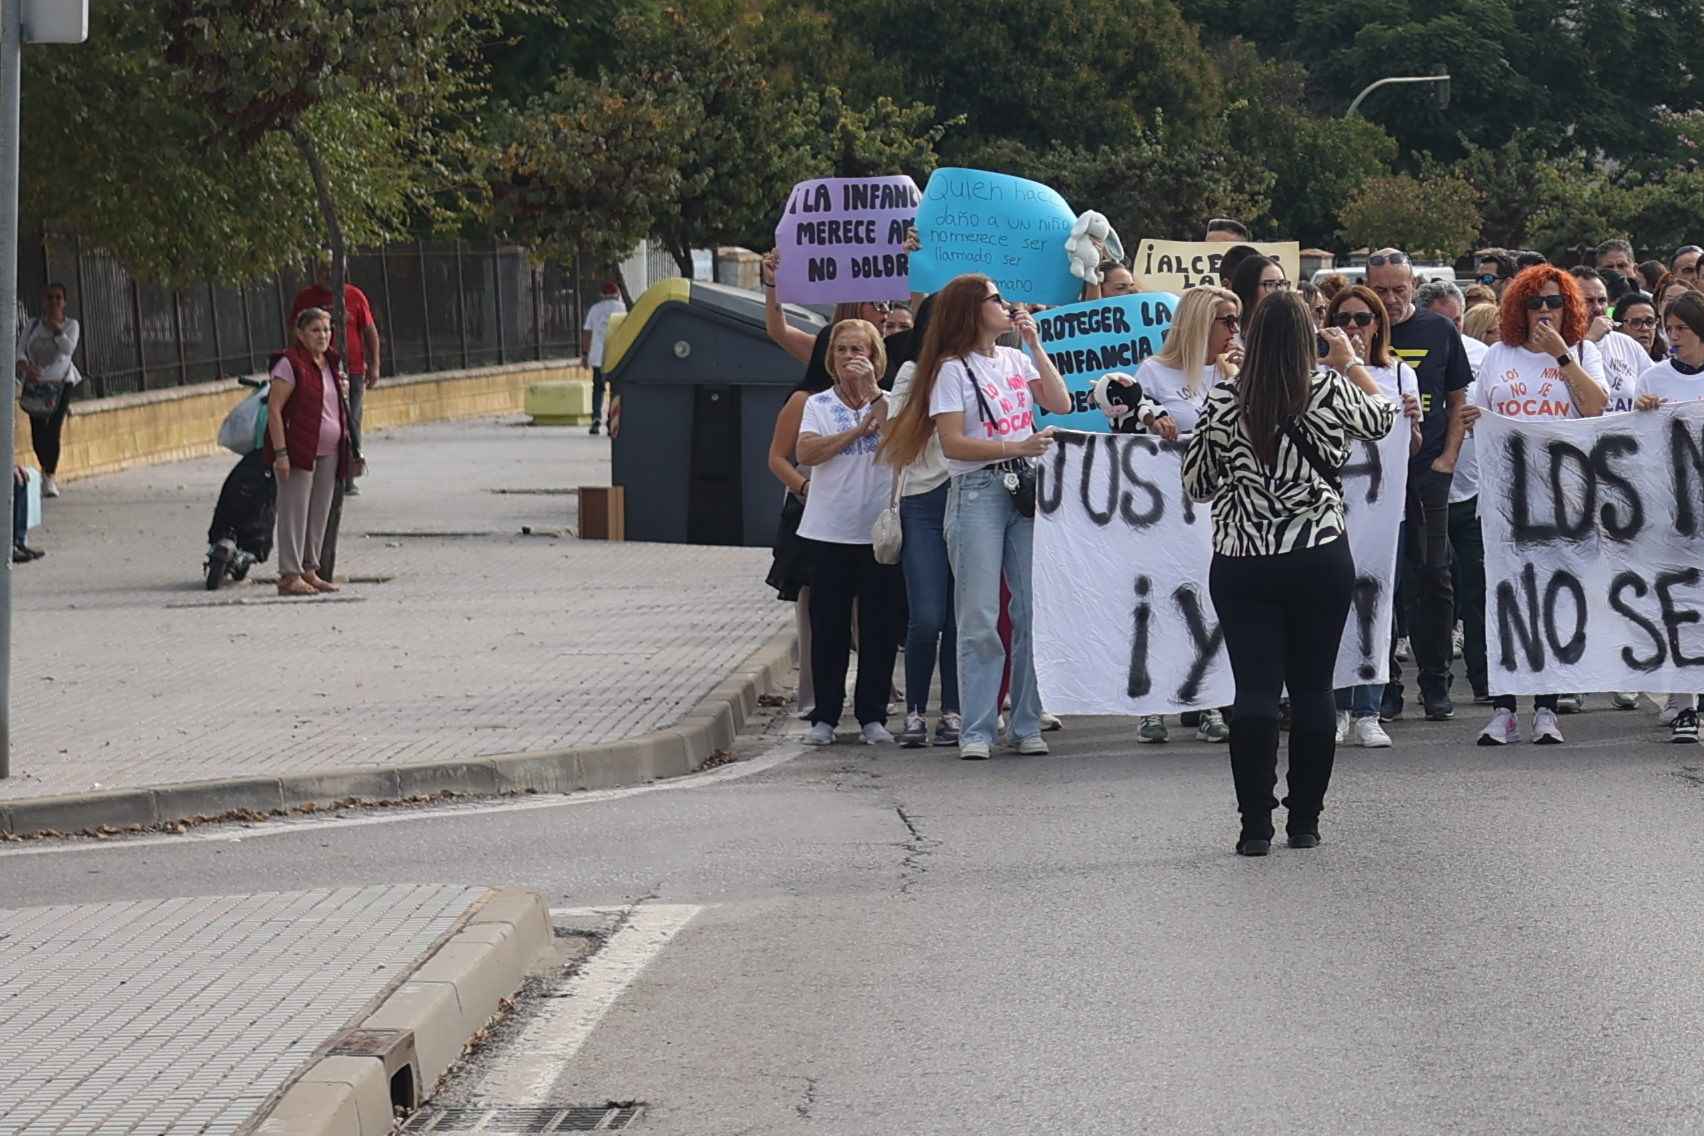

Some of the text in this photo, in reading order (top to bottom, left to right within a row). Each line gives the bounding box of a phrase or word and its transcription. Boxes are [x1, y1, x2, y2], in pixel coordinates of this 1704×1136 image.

[843, 183, 919, 212] INFANC
[796, 219, 877, 246] MERECE
[1021, 237, 1049, 253] ser
[808, 253, 909, 283] NO DOLOR
[935, 246, 1024, 267] llamado ser
[994, 278, 1034, 293] mano
[1140, 300, 1173, 327] LA
[1510, 381, 1553, 399] NO SE
[1496, 399, 1570, 417] TOCAN
[1506, 431, 1645, 547] LOS
[1496, 561, 1588, 673] NO
